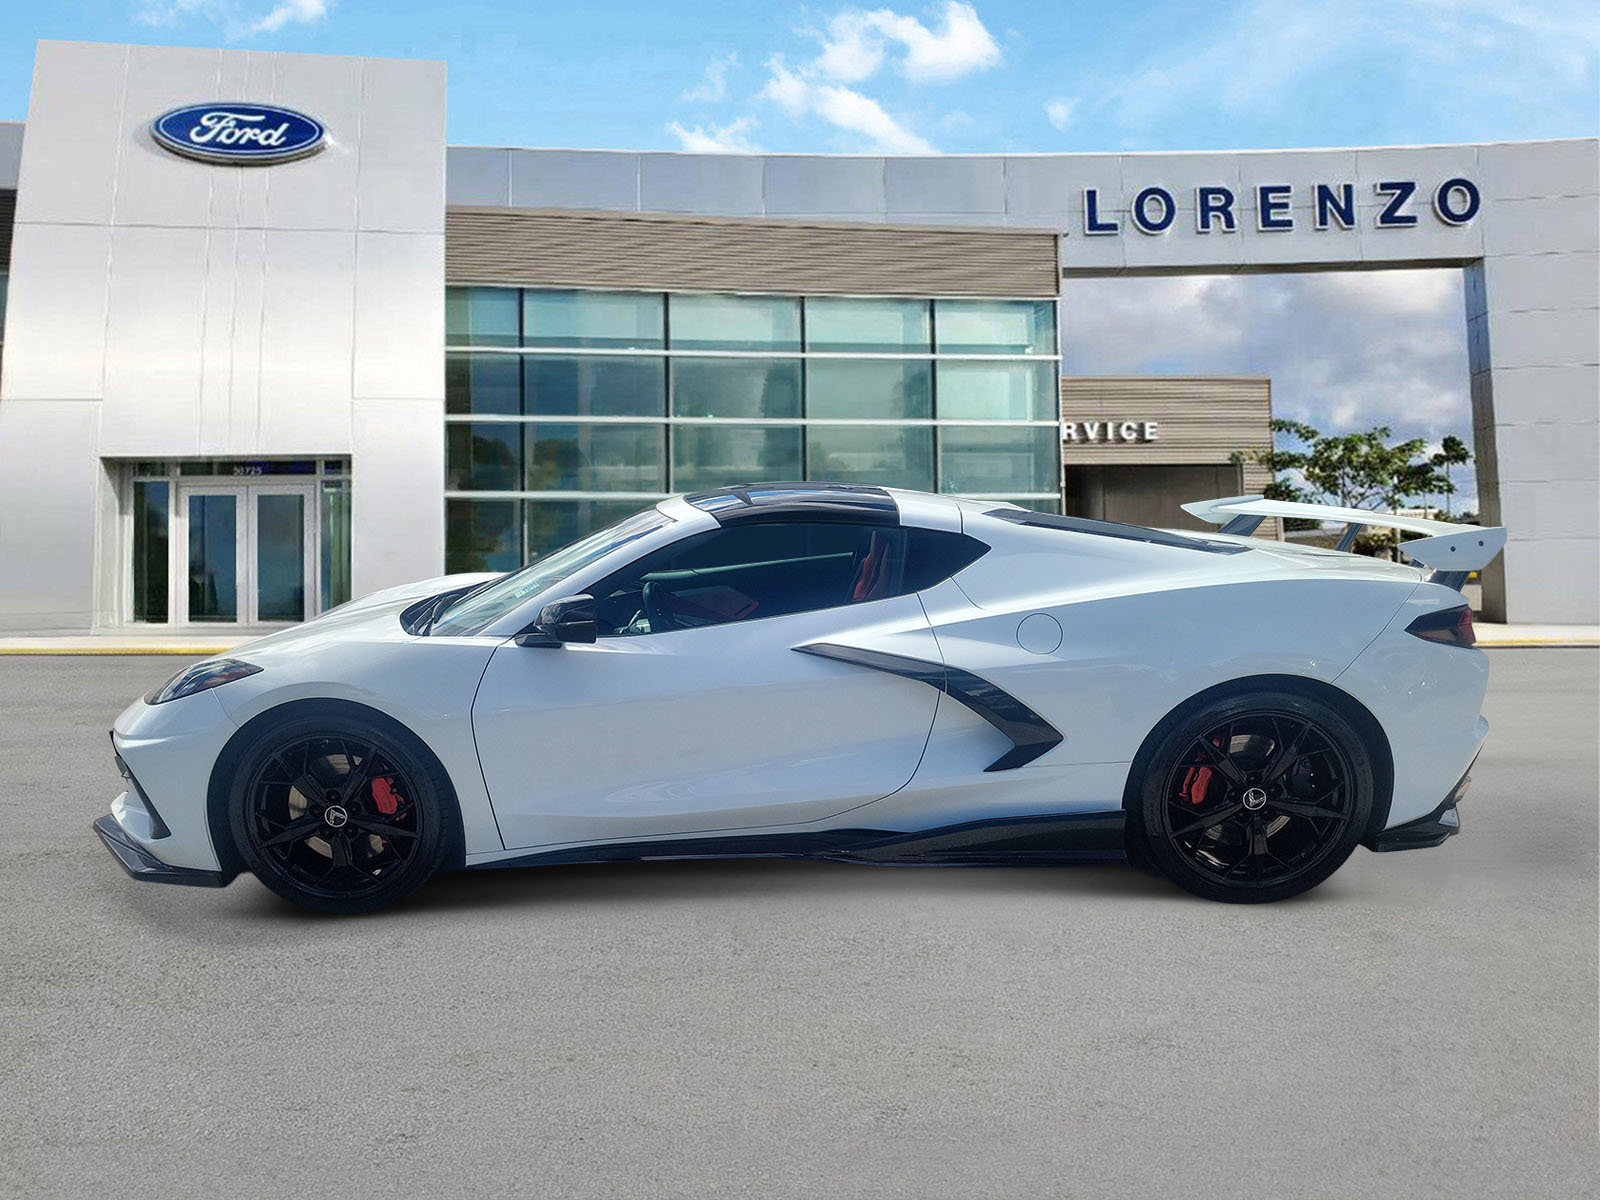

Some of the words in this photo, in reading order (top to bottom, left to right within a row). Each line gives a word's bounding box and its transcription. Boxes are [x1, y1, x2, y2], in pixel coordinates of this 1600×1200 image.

[189, 112, 289, 146] Ford
[1084, 178, 1481, 234] LORENZO
[1062, 421, 1159, 440] RVICE
